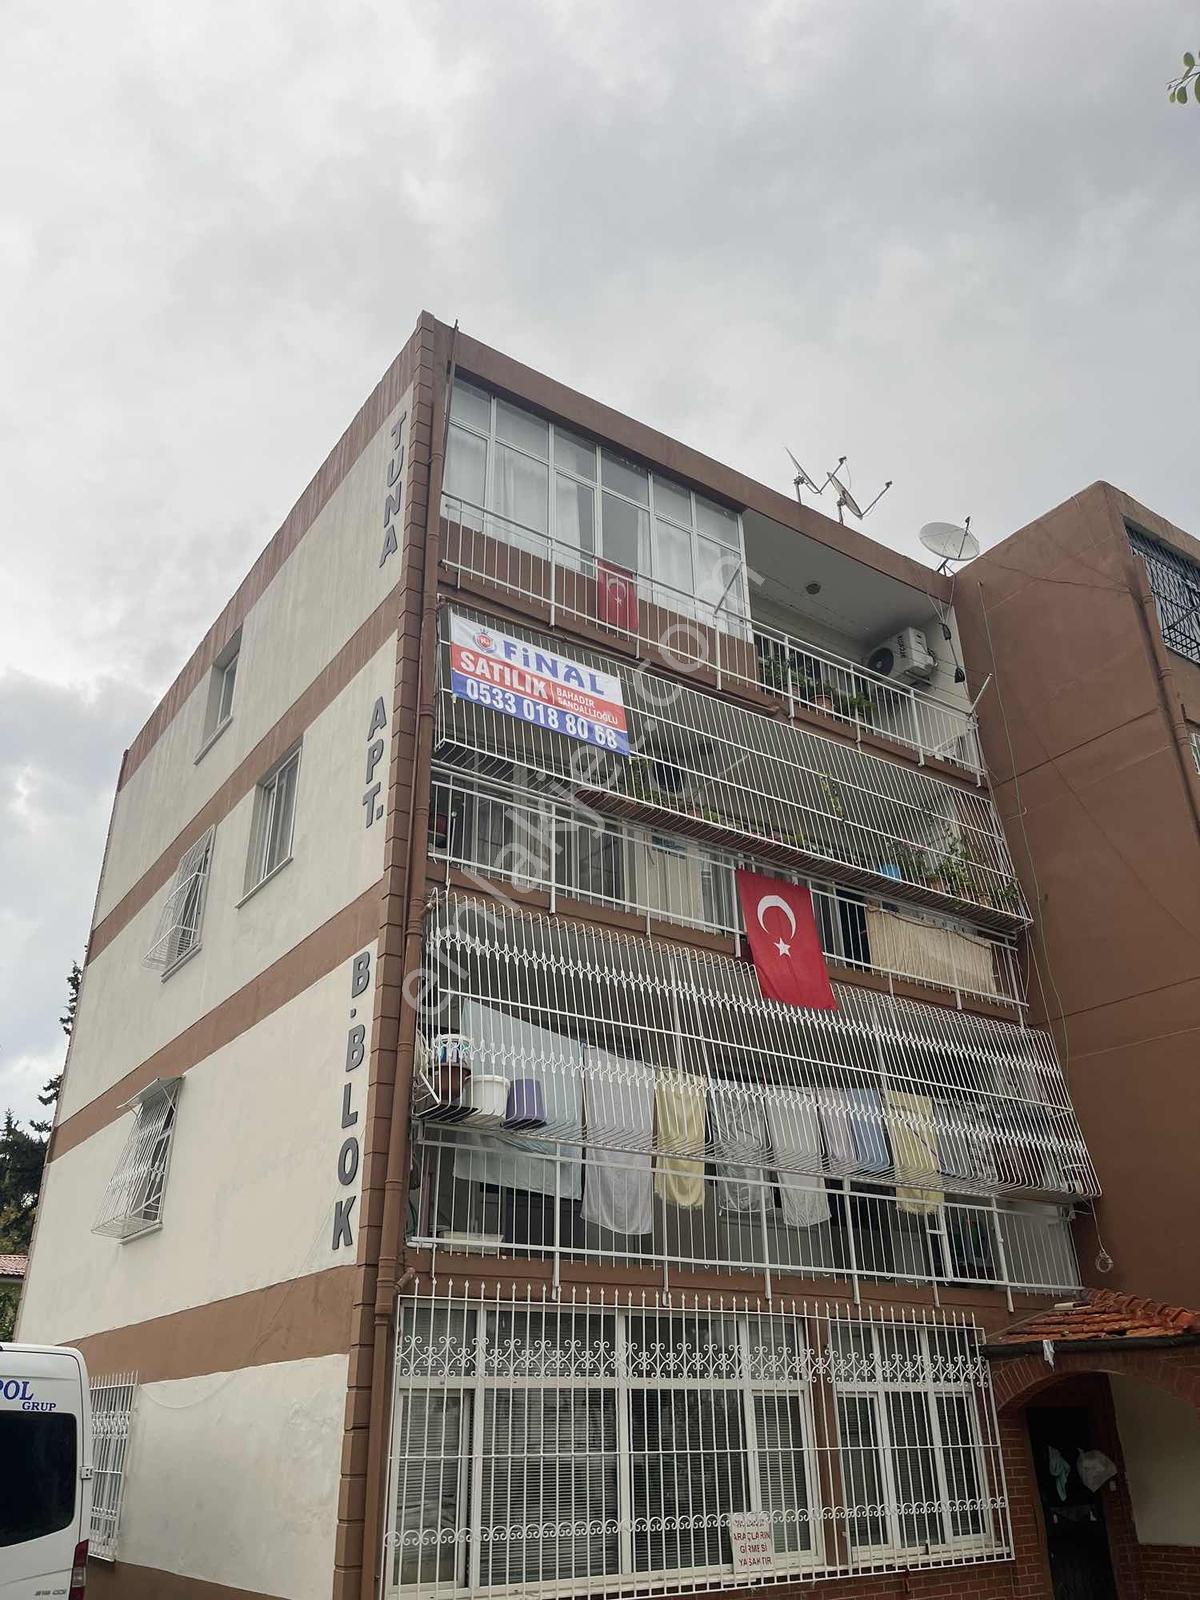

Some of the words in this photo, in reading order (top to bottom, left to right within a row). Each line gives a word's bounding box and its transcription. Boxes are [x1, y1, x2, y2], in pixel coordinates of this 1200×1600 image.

[379, 411, 407, 568] TUNA
[460, 651, 549, 699] SATILIK
[556, 687, 595, 709] BAHADIR
[466, 678, 517, 714] 0533
[523, 699, 559, 729] 018
[565, 713, 588, 739] 80
[362, 696, 387, 829] APT.
[0, 1379, 34, 1401] OL
[22, 1401, 57, 1411] GRUP
